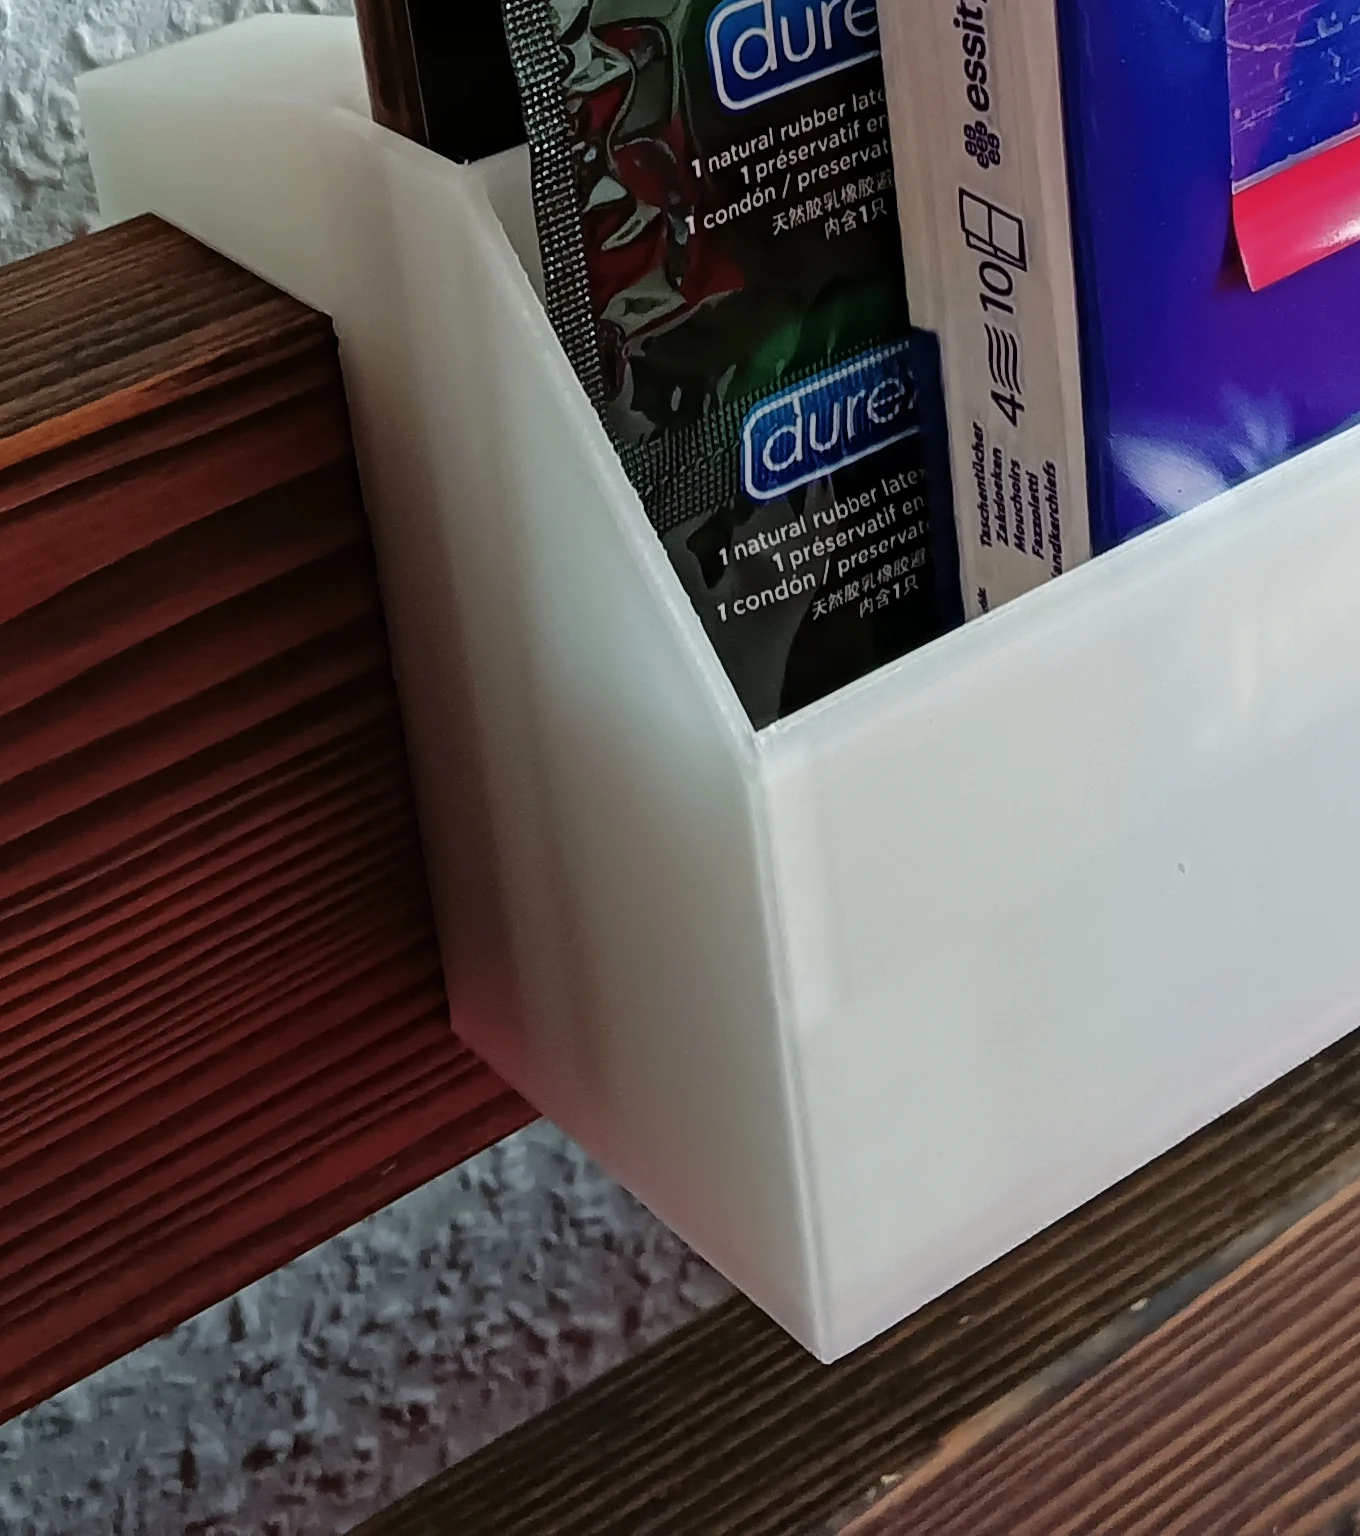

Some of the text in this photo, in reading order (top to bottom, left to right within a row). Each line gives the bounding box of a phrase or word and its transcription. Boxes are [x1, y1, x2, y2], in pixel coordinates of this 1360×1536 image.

[691, 88, 885, 178] 1 natural rubber lat
[740, 165, 750, 185] 1
[756, 119, 861, 183] préservatif
[685, 215, 696, 235] 1
[703, 184, 776, 230] condón
[798, 137, 889, 193] preservat
[979, 261, 1025, 427] 4 10
[719, 548, 728, 565] 1
[735, 515, 806, 561] natural
[813, 487, 877, 528] rubber
[972, 421, 992, 548] Taschentücher
[991, 447, 1009, 547] Zakdoeken
[1008, 458, 1027, 555] Mouchoirs
[1025, 470, 1044, 560] Fazzoletti
[717, 602, 727, 621] 1
[734, 572, 816, 615] condón
[838, 520, 929, 578] preservat
[772, 495, 925, 572] 1 préservatif en
